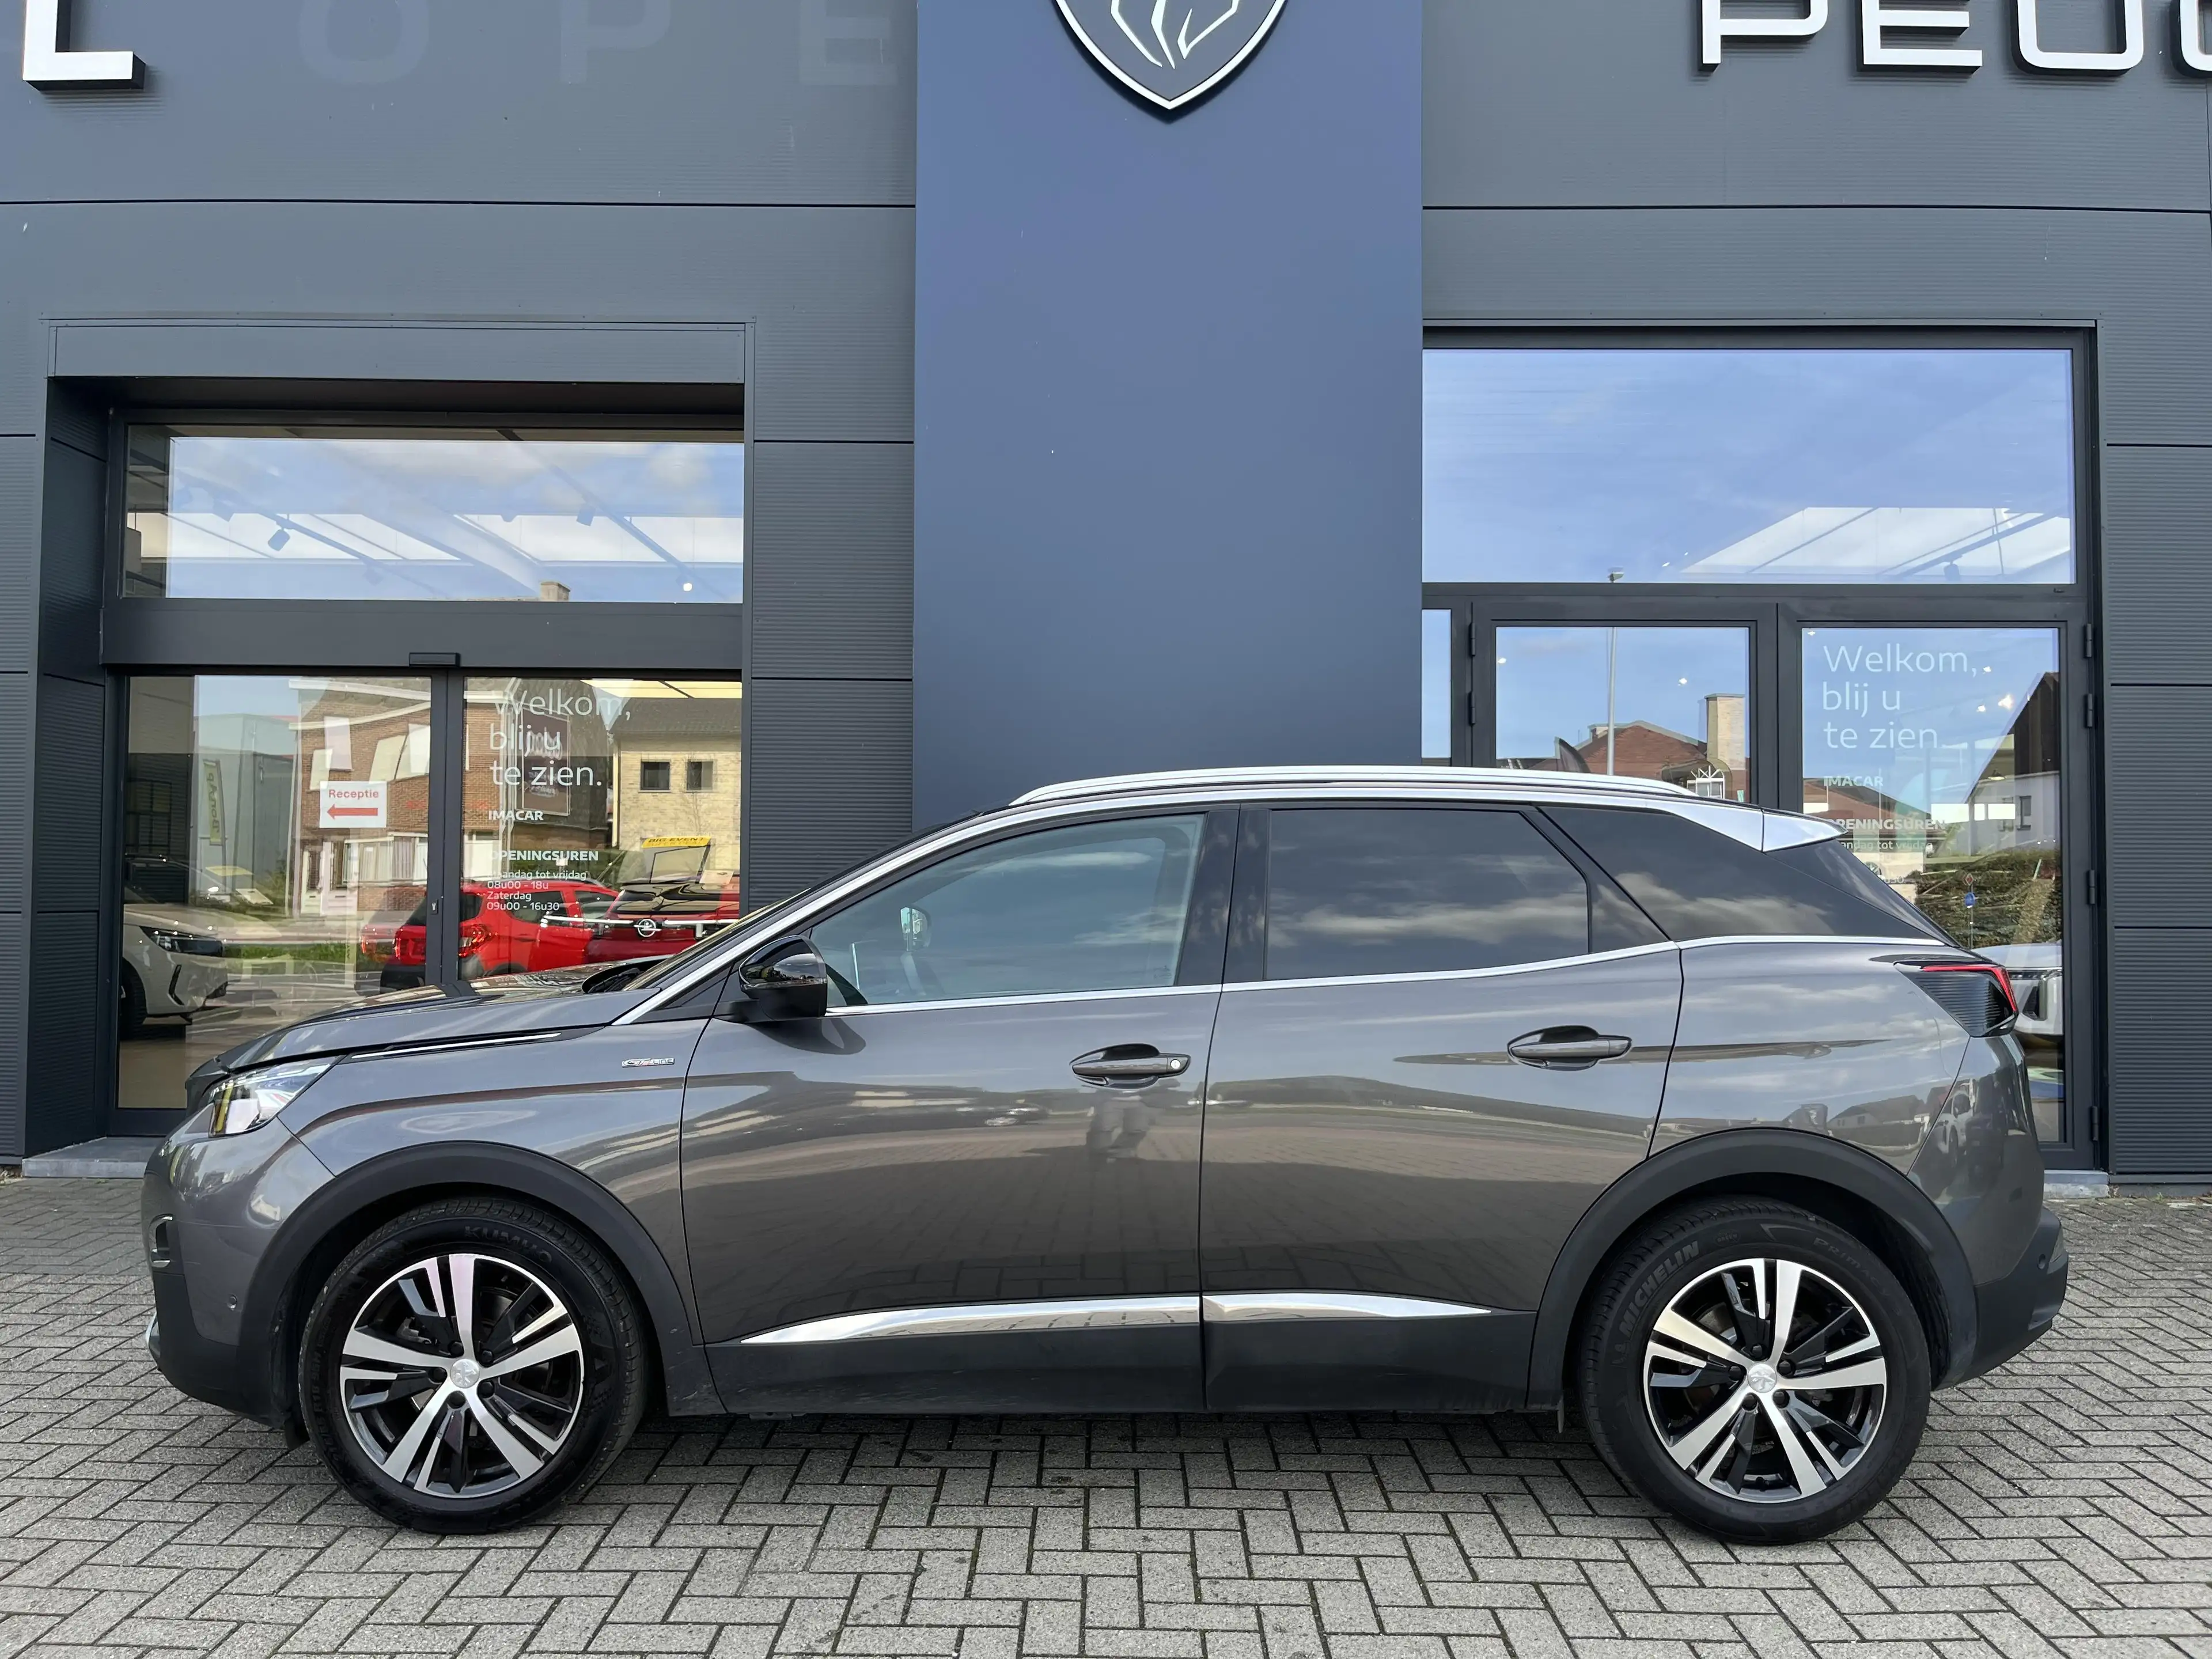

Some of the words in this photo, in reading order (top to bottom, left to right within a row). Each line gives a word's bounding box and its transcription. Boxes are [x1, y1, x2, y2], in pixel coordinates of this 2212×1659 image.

[1702, 0, 2212, 73] PEU
[1823, 643, 1977, 677] Welkom,
[495, 688, 631, 721] Welkom,
[1823, 681, 1869, 718] blij
[1882, 691, 1900, 710] u
[490, 722, 532, 757] blij
[544, 731, 560, 751] u
[1823, 722, 1858, 749] te
[490, 760, 521, 786] te
[531, 760, 602, 786] zien.
[1823, 775, 1884, 787] IMACAR
[328, 789, 379, 800] Receptie
[488, 810, 544, 821] IMACAR
[1878, 840, 1893, 850] tot
[487, 881, 521, 889] 08u00
[531, 881, 549, 889] 18u
[489, 870, 533, 880] aandag
[535, 870, 550, 879] tot
[552, 870, 586, 881] vrijdag
[487, 891, 532, 902] Zaterdag
[487, 902, 520, 911] 09u00
[530, 902, 560, 911] 16u30
[464, 1225, 552, 1263] KUMHO
[1619, 1240, 1700, 1336] MICHELIN
